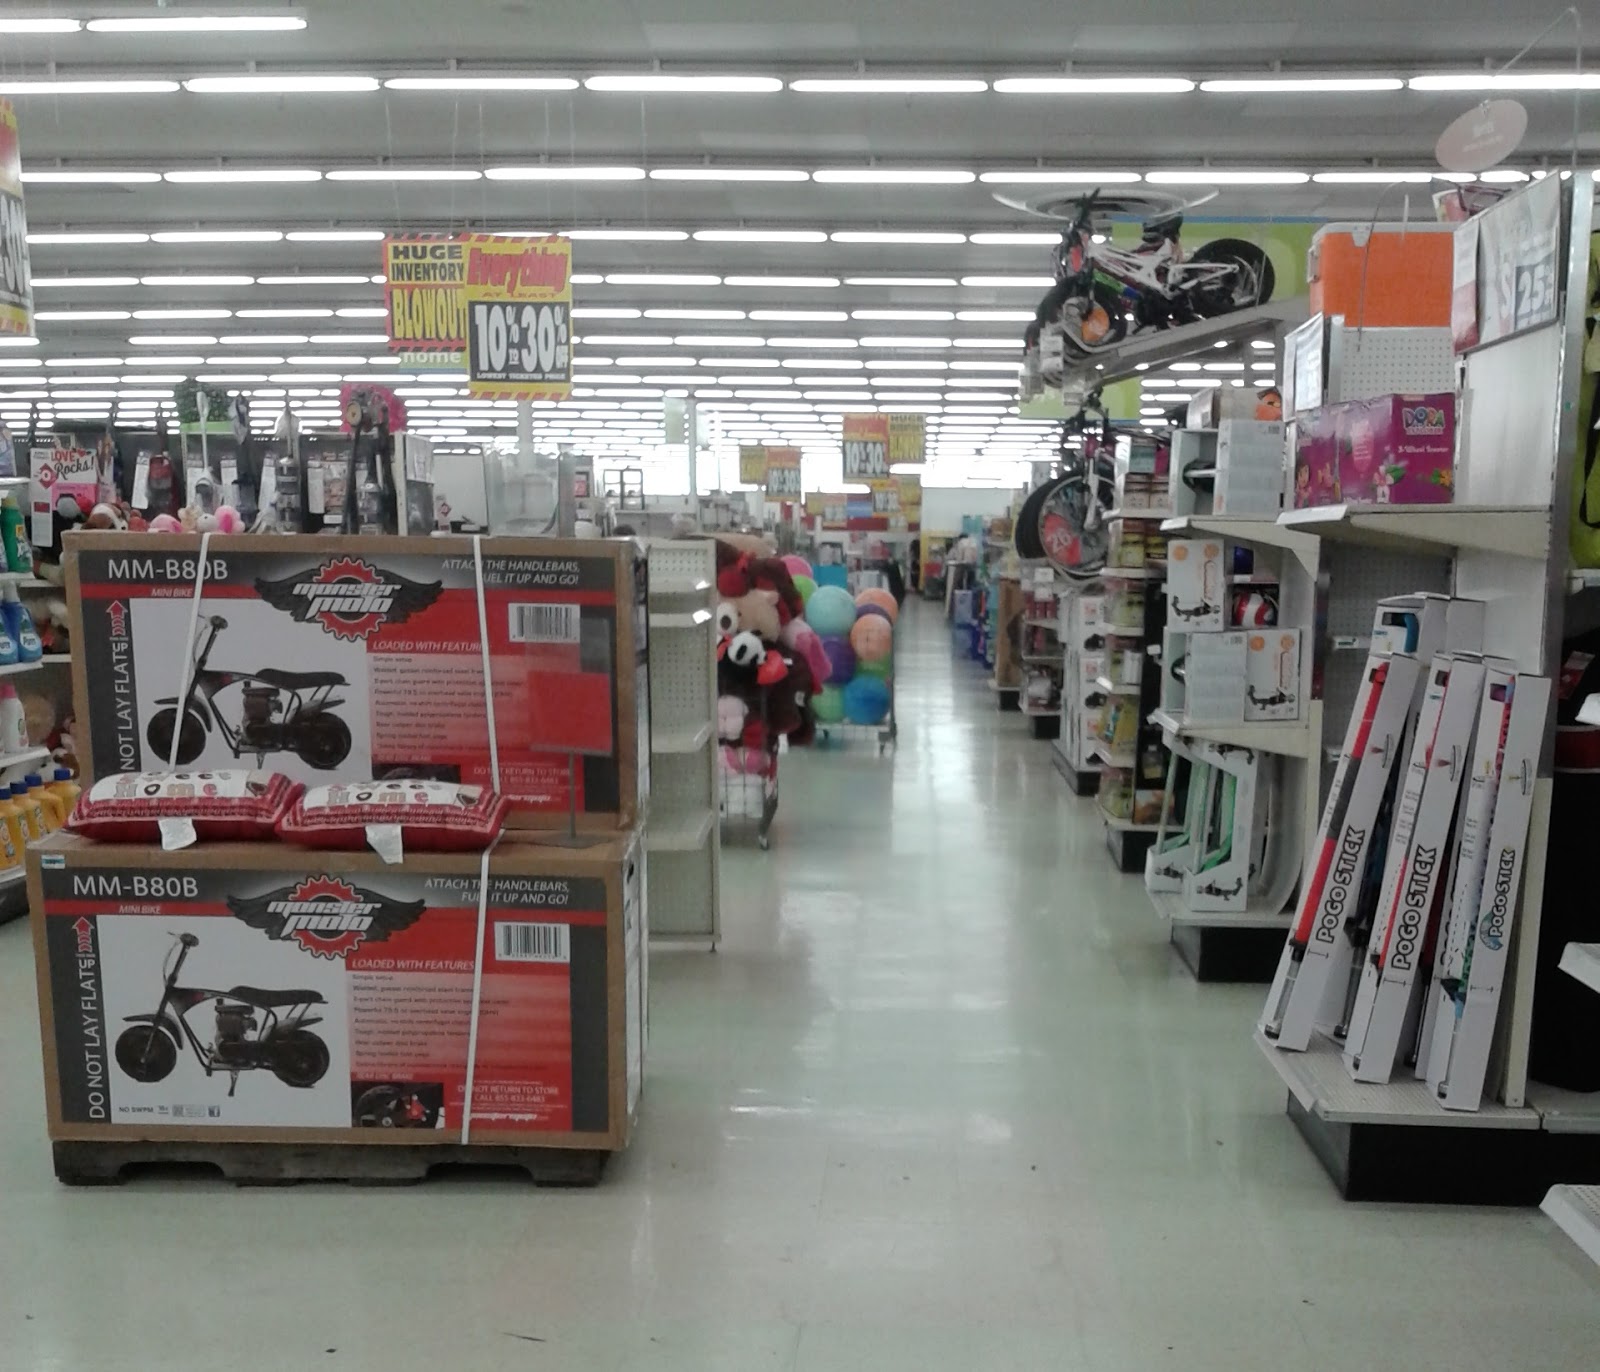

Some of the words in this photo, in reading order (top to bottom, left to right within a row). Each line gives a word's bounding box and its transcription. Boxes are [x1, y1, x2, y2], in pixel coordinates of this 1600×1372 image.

[393, 245, 463, 260] HUGE
[391, 262, 464, 281] INVENTORY
[1402, 406, 1446, 429] DORA
[51, 449, 76, 462] LOVE
[54, 455, 95, 481] Rocks!
[108, 559, 229, 580] MM-B80B
[441, 559, 482, 570] ATTAC
[487, 560, 505, 571] THE
[508, 560, 580, 573] HANDLEBARS,
[481, 573, 502, 584] UEL
[516, 573, 531, 584] UP
[533, 574, 557, 585] AND
[559, 575, 579, 585] GO!
[373, 641, 414, 651] LOADED
[416, 641, 441, 651] WITH
[112, 651, 130, 693] FLAT
[115, 698, 133, 730] LAY
[118, 734, 136, 771] NOT
[1316, 886, 1347, 944] POGO
[1333, 824, 1365, 886] STICK
[1405, 844, 1437, 909] STICK
[1495, 848, 1515, 896] STICK
[73, 875, 199, 898] MM-B80B
[424, 877, 469, 889] ATTACH
[494, 880, 570, 893] HANDLEBARS,
[141, 906, 161, 914] BIKE
[503, 892, 519, 903] UP
[520, 894, 545, 904] AND
[547, 894, 569, 905] GO!
[1488, 894, 1508, 938] POGO
[1391, 909, 1421, 971] POGO
[352, 959, 395, 969] LOADED
[397, 959, 423, 969] WITH
[424, 959, 474, 970] FEATURES
[79, 969, 97, 1010] FLAT
[82, 1014, 100, 1047] LAY
[85, 1050, 103, 1088] NOT
[88, 1092, 105, 1118] DO
